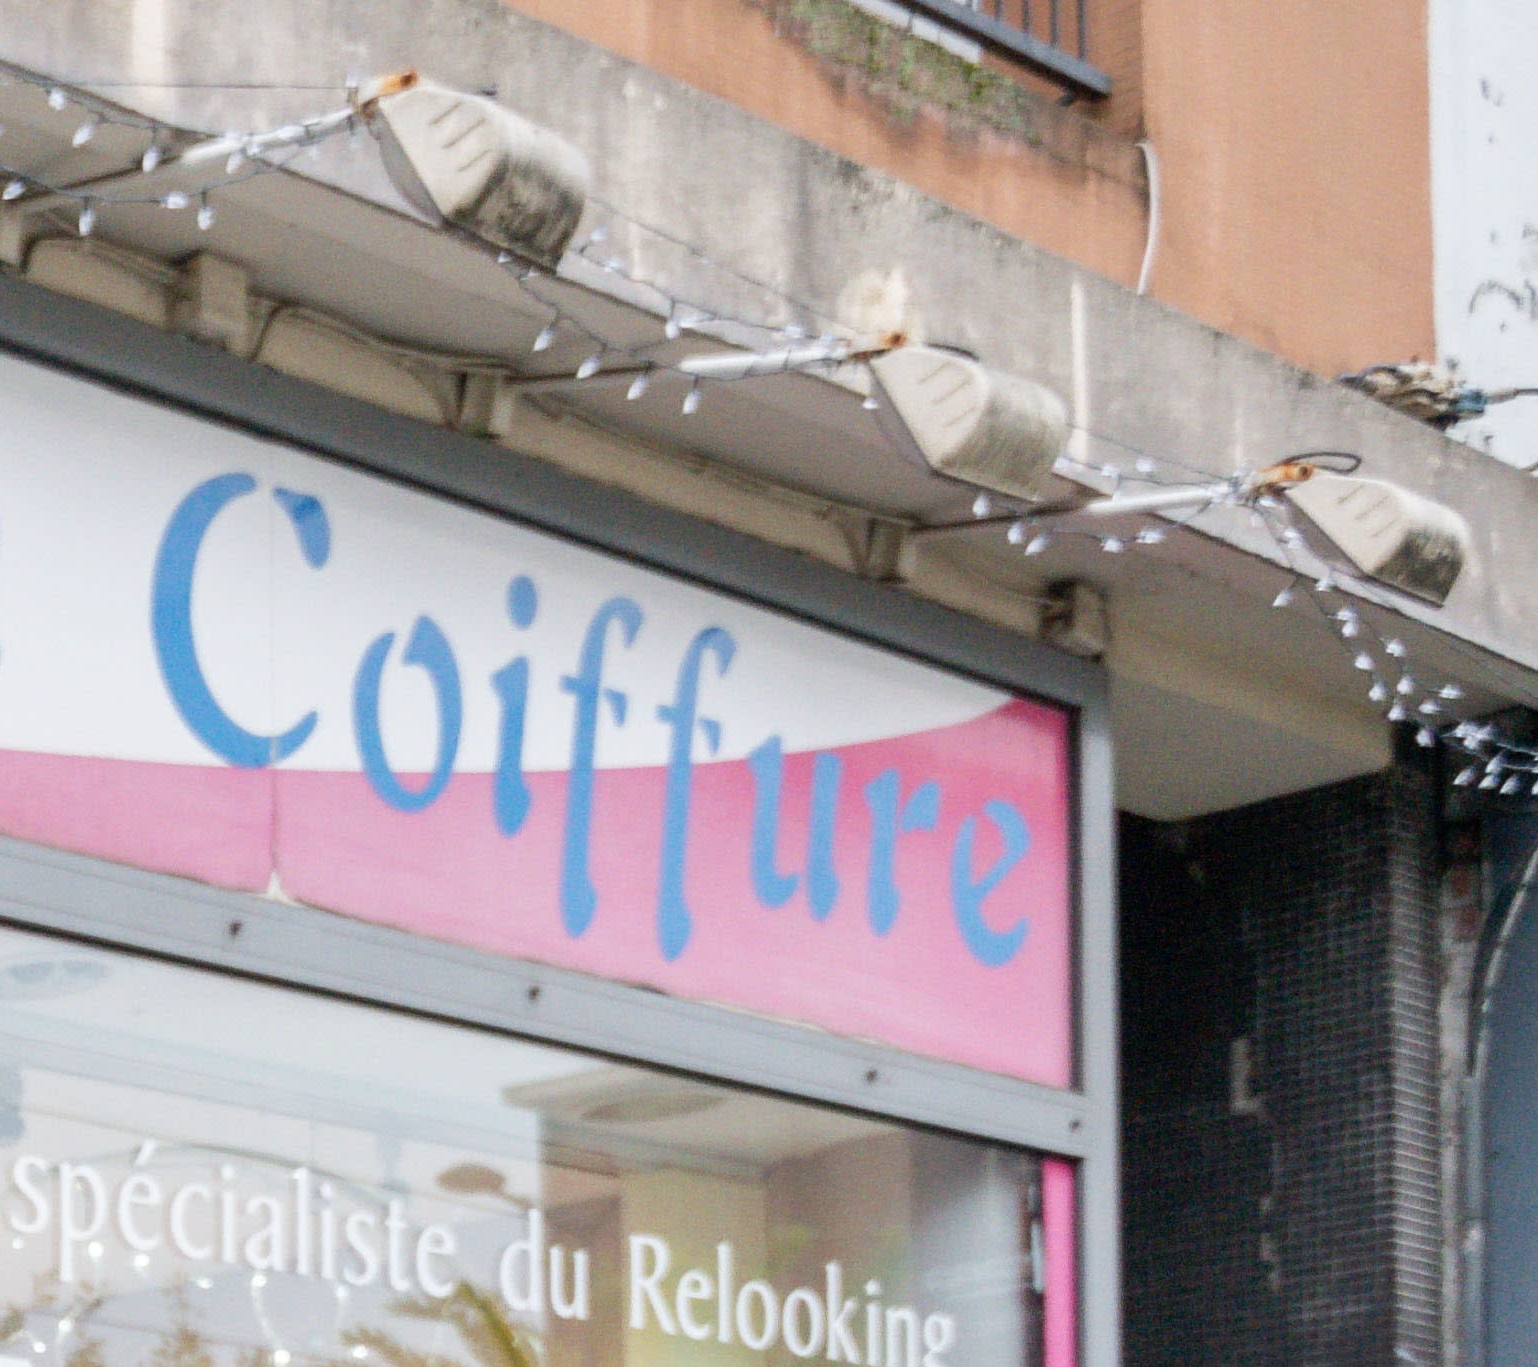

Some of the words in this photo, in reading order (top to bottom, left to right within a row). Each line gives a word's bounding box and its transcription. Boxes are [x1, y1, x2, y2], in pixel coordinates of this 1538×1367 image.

[151, 470, 1034, 963] Coiffure
[9, 1140, 464, 1298] spécialiste
[499, 1208, 588, 1319] du
